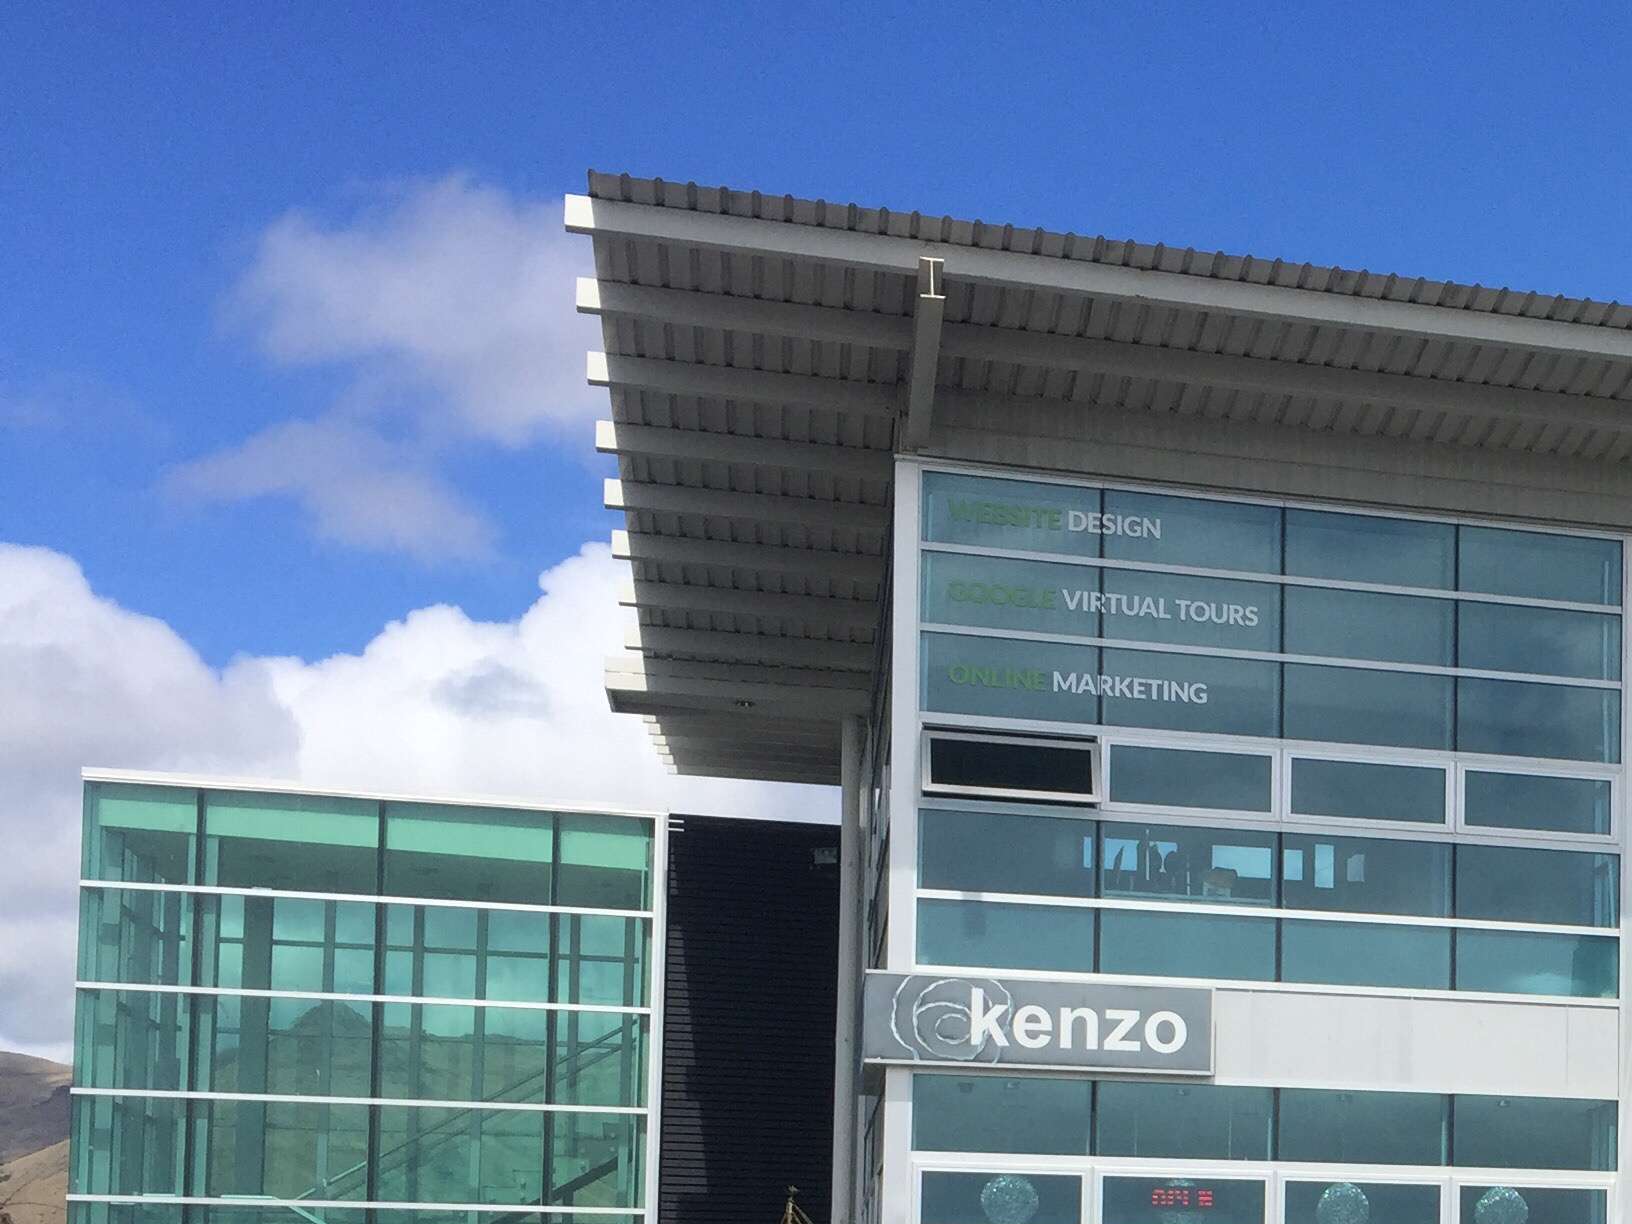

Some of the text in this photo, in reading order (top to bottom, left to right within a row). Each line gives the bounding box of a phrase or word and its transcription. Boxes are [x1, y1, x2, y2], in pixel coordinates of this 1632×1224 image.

[1067, 510, 1162, 540] DESIGN
[1061, 588, 1172, 621] VIRTUAL
[1175, 598, 1260, 627] TOURS
[947, 663, 1209, 704] ONLINE MARKETING
[970, 987, 1188, 1054] kenzo
